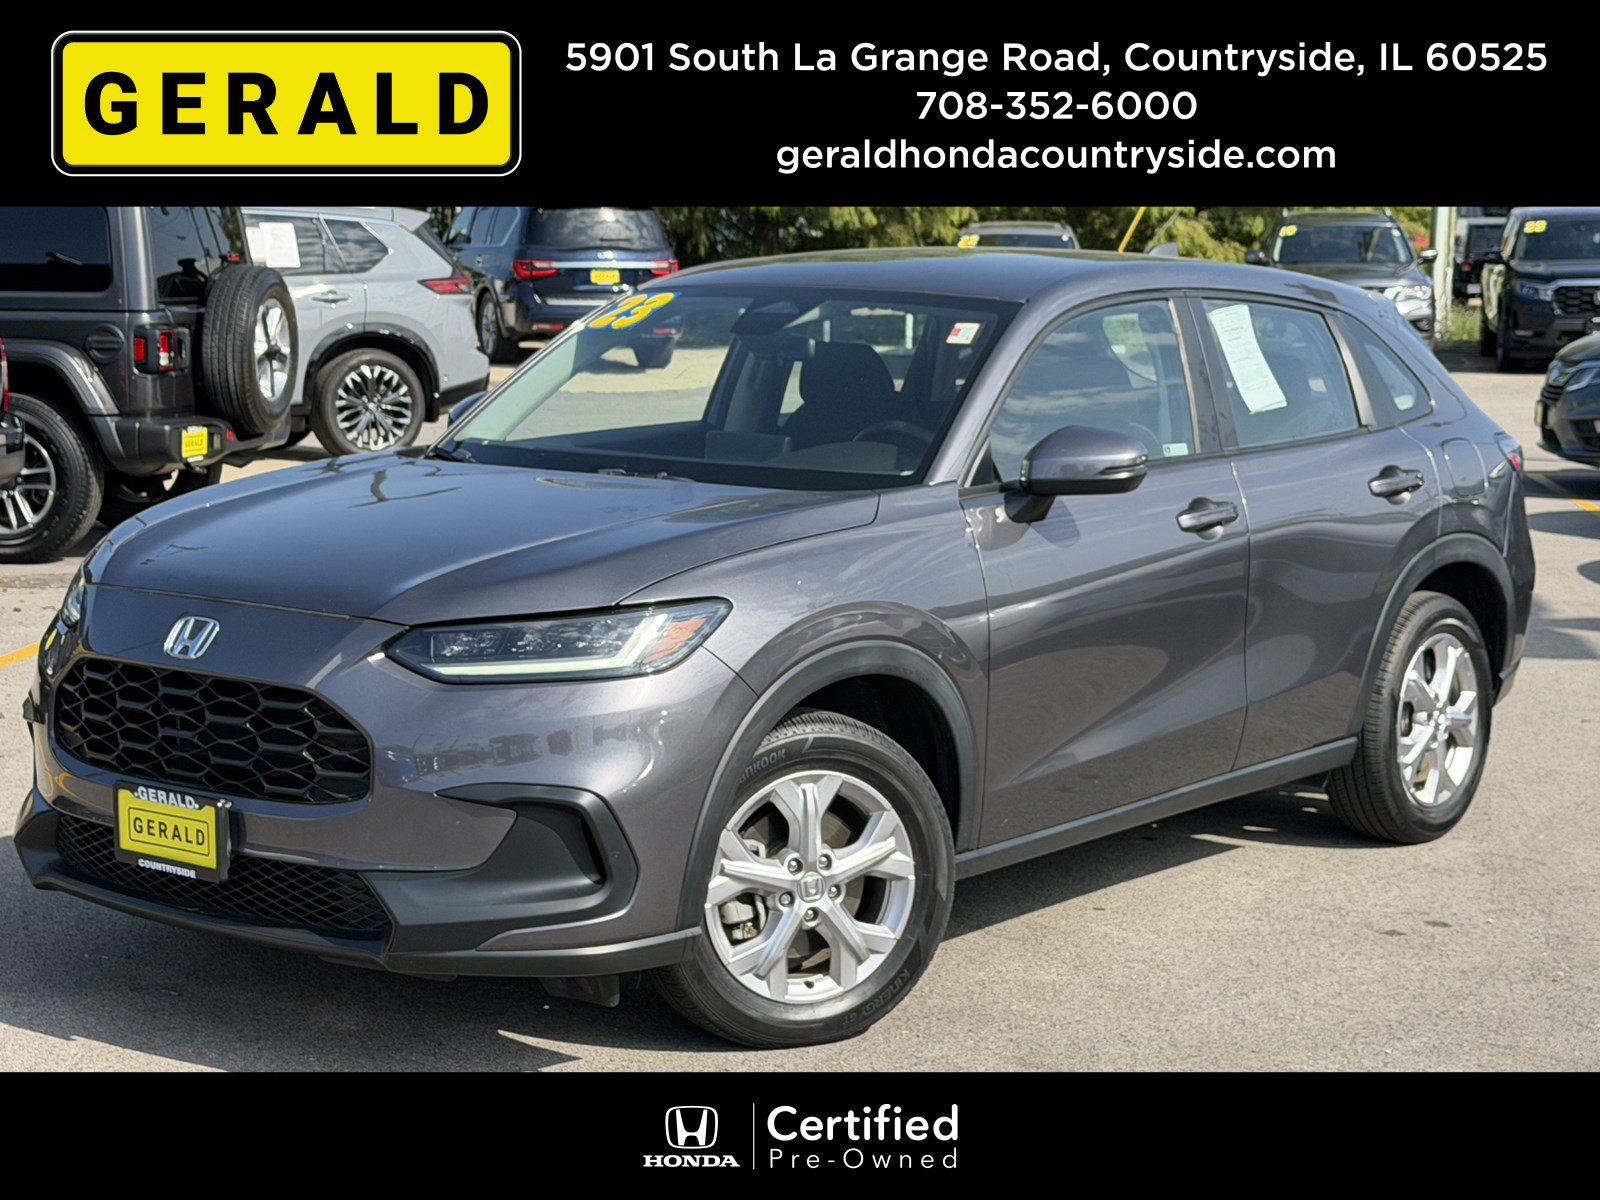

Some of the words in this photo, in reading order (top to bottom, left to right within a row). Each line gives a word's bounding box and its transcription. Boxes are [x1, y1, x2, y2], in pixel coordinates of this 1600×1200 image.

[588, 292, 675, 330] 23
[137, 786, 196, 809] GERALD
[133, 816, 206, 847] GERALD
[137, 858, 197, 879] COUNTRYSIDE
